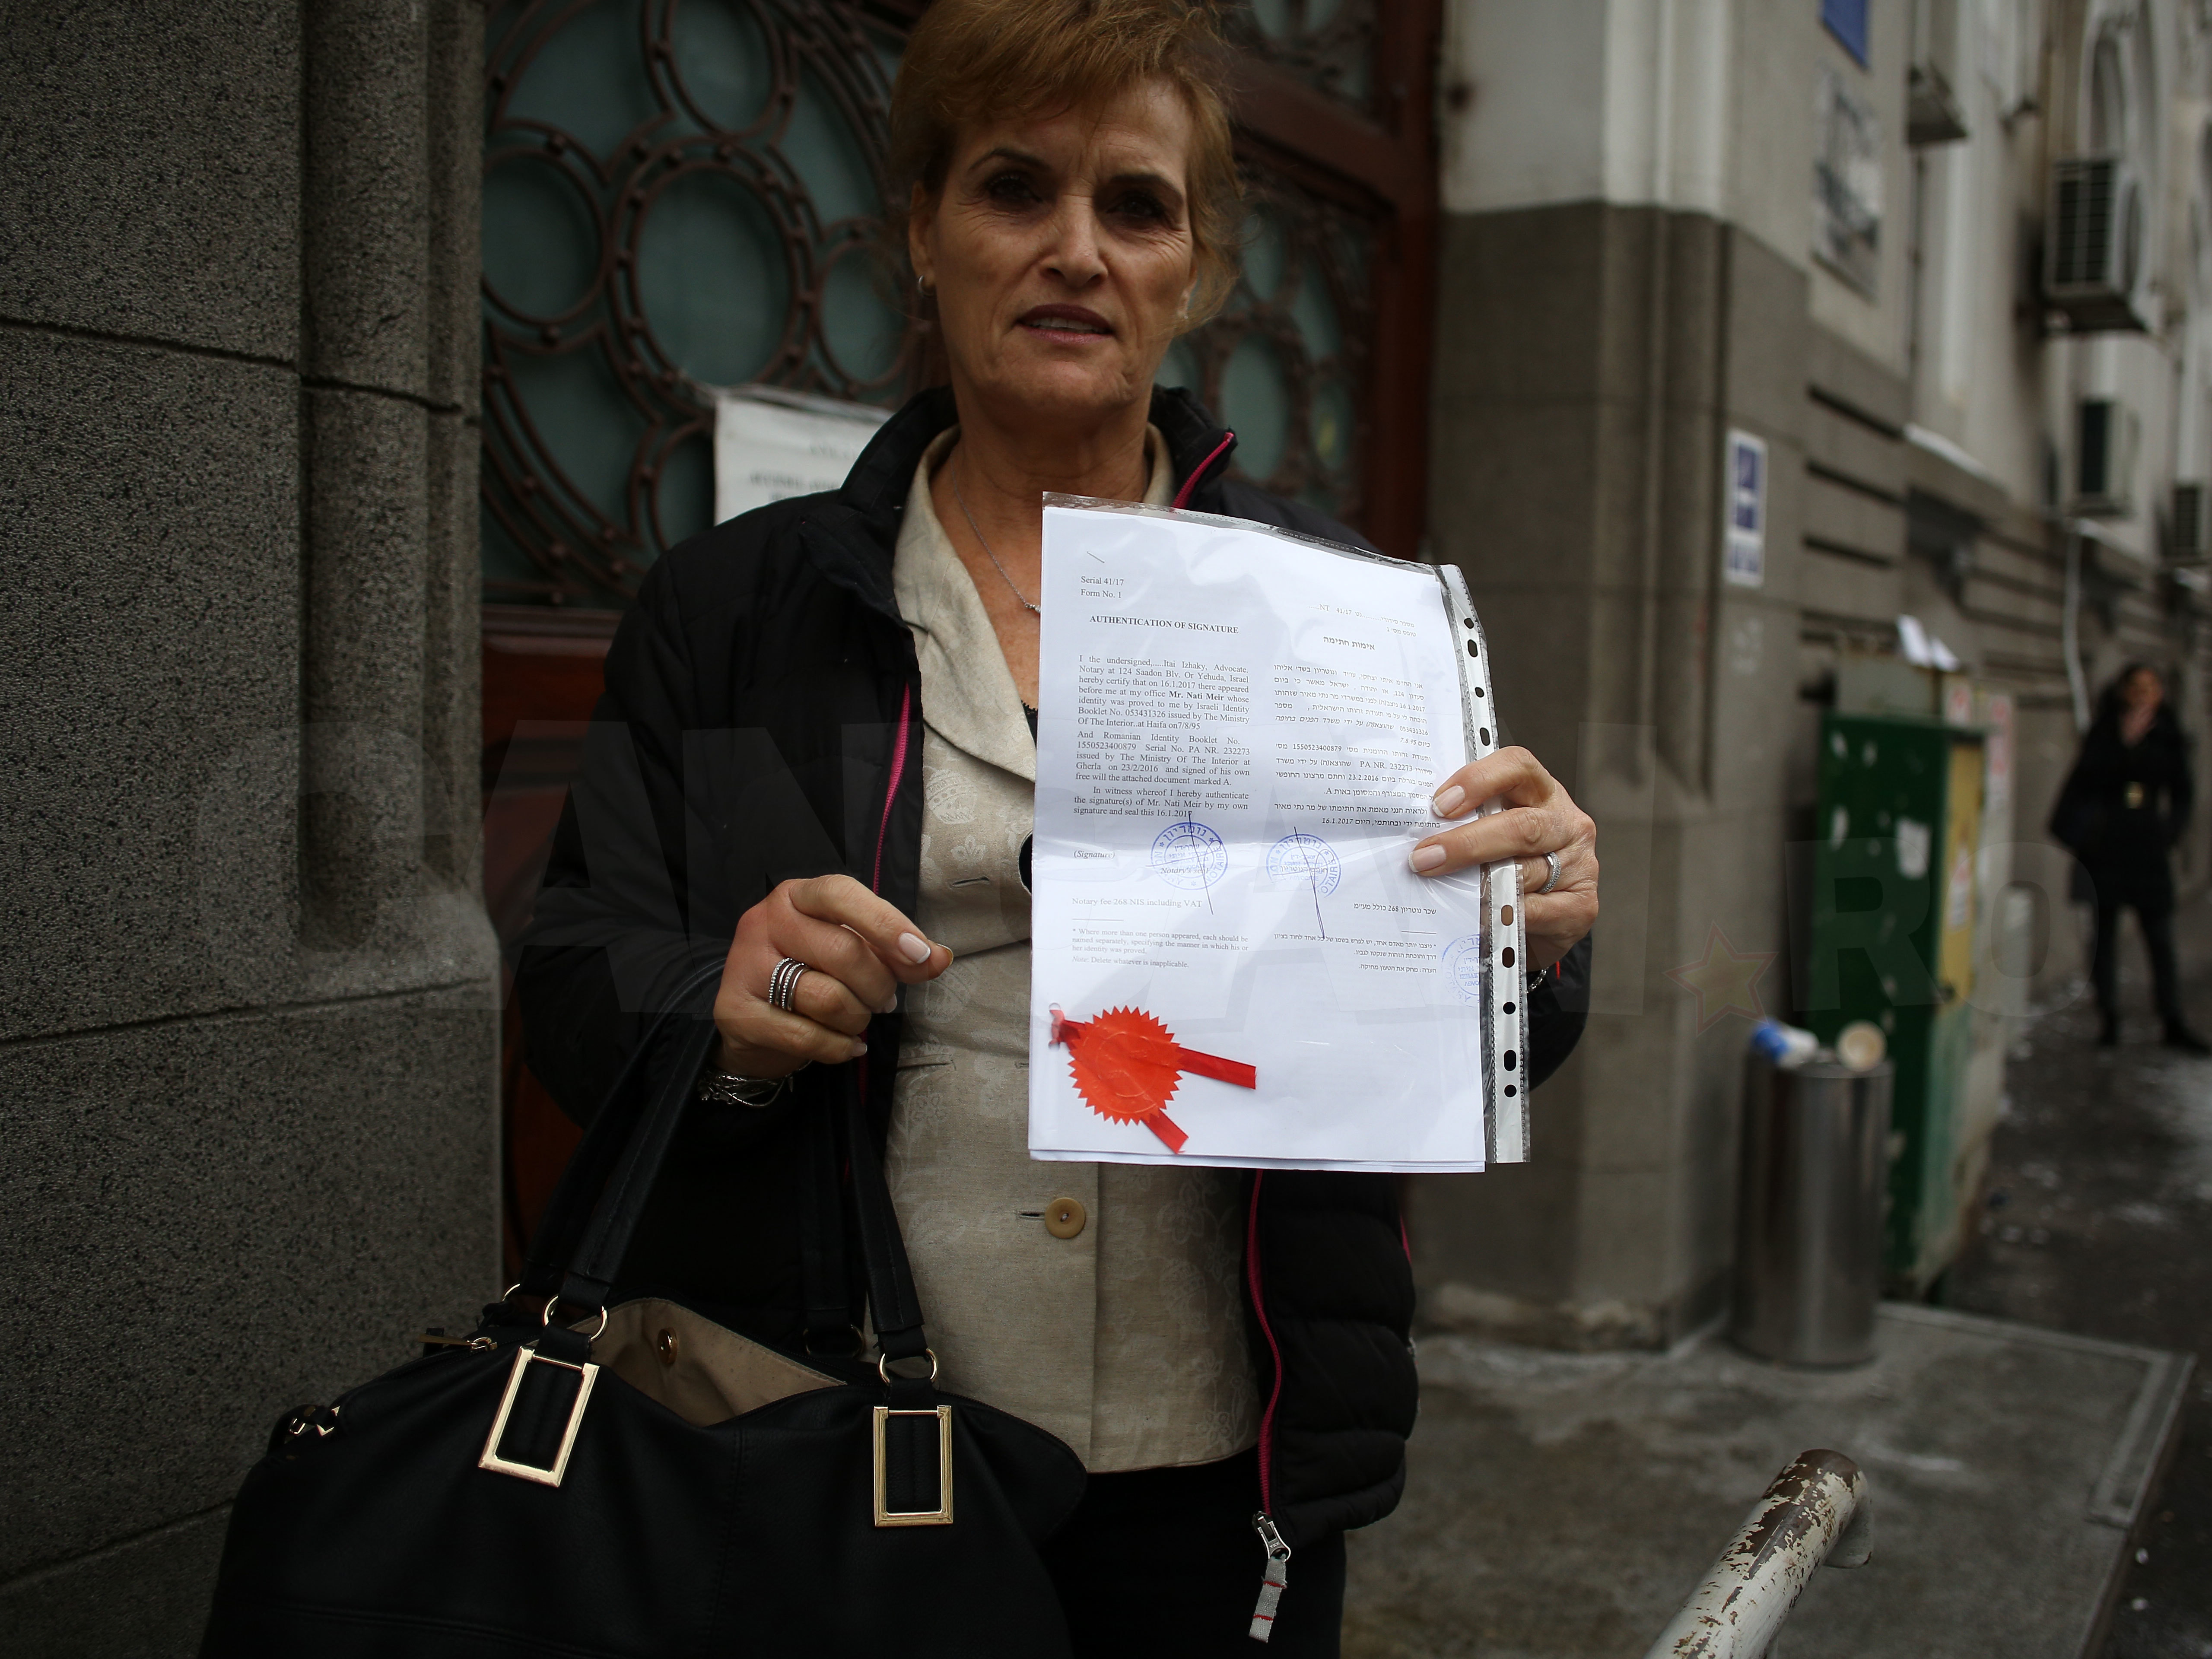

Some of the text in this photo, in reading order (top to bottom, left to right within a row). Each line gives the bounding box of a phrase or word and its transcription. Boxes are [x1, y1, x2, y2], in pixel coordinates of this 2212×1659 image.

[1081, 576, 1124, 586] Serial 41/17
[1081, 588, 1100, 597] Form
[1090, 616, 1172, 627] AUTHENTICATION
[1188, 623, 1238, 633] SIGNATURE
[1182, 661, 1207, 671] Izhaky,
[1214, 664, 1248, 673] Advocate.
[1079, 665, 1104, 675] Notary
[1135, 668, 1162, 677] Saadon
[1166, 670, 1180, 678] Blv.
[1198, 672, 1226, 682] Yehuda,
[1230, 675, 1249, 683] Israel
[1079, 675, 1104, 685] hereby
[1106, 677, 1130, 686] certify
[1161, 680, 1195, 689] 16.1.2017
[1079, 686, 1102, 694] before
[1206, 693, 1224, 701] Meir
[1078, 696, 1106, 706] identity
[1128, 699, 1154, 708] proved
[1184, 701, 1193, 711] by
[1197, 702, 1218, 710] Israeli
[1223, 704, 1249, 714] Identity
[1400, 703, 1425, 712] 16.1.2017
[1078, 706, 1107, 715] Booklet
[1125, 709, 1166, 718] 053431326
[1168, 711, 1190, 719] issued
[1192, 712, 1202, 721] by
[1220, 714, 1249, 724] Ministry
[1399, 726, 1428, 735] 053431326
[1103, 731, 1141, 740] Romanian
[1151, 734, 1179, 744] Identity
[1189, 735, 1217, 744] Booklet
[1078, 741, 1136, 750] 1550523400879
[1224, 747, 1250, 755] 232273
[1105, 753, 1115, 762] by
[1140, 754, 1171, 764] Ministry
[1076, 762, 1101, 770] Gherla
[1121, 763, 1158, 772] 23/2/2016
[1182, 766, 1205, 775] signed
[1154, 775, 1190, 784] document
[1177, 789, 1202, 799] hereby
[1205, 791, 1249, 799] authenticate
[1089, 798, 1132, 806] signature(s)
[1205, 801, 1214, 810] by
[1074, 850, 1115, 859] (Signature)
[1072, 898, 1098, 906] Notary
[1147, 899, 1182, 908] including
